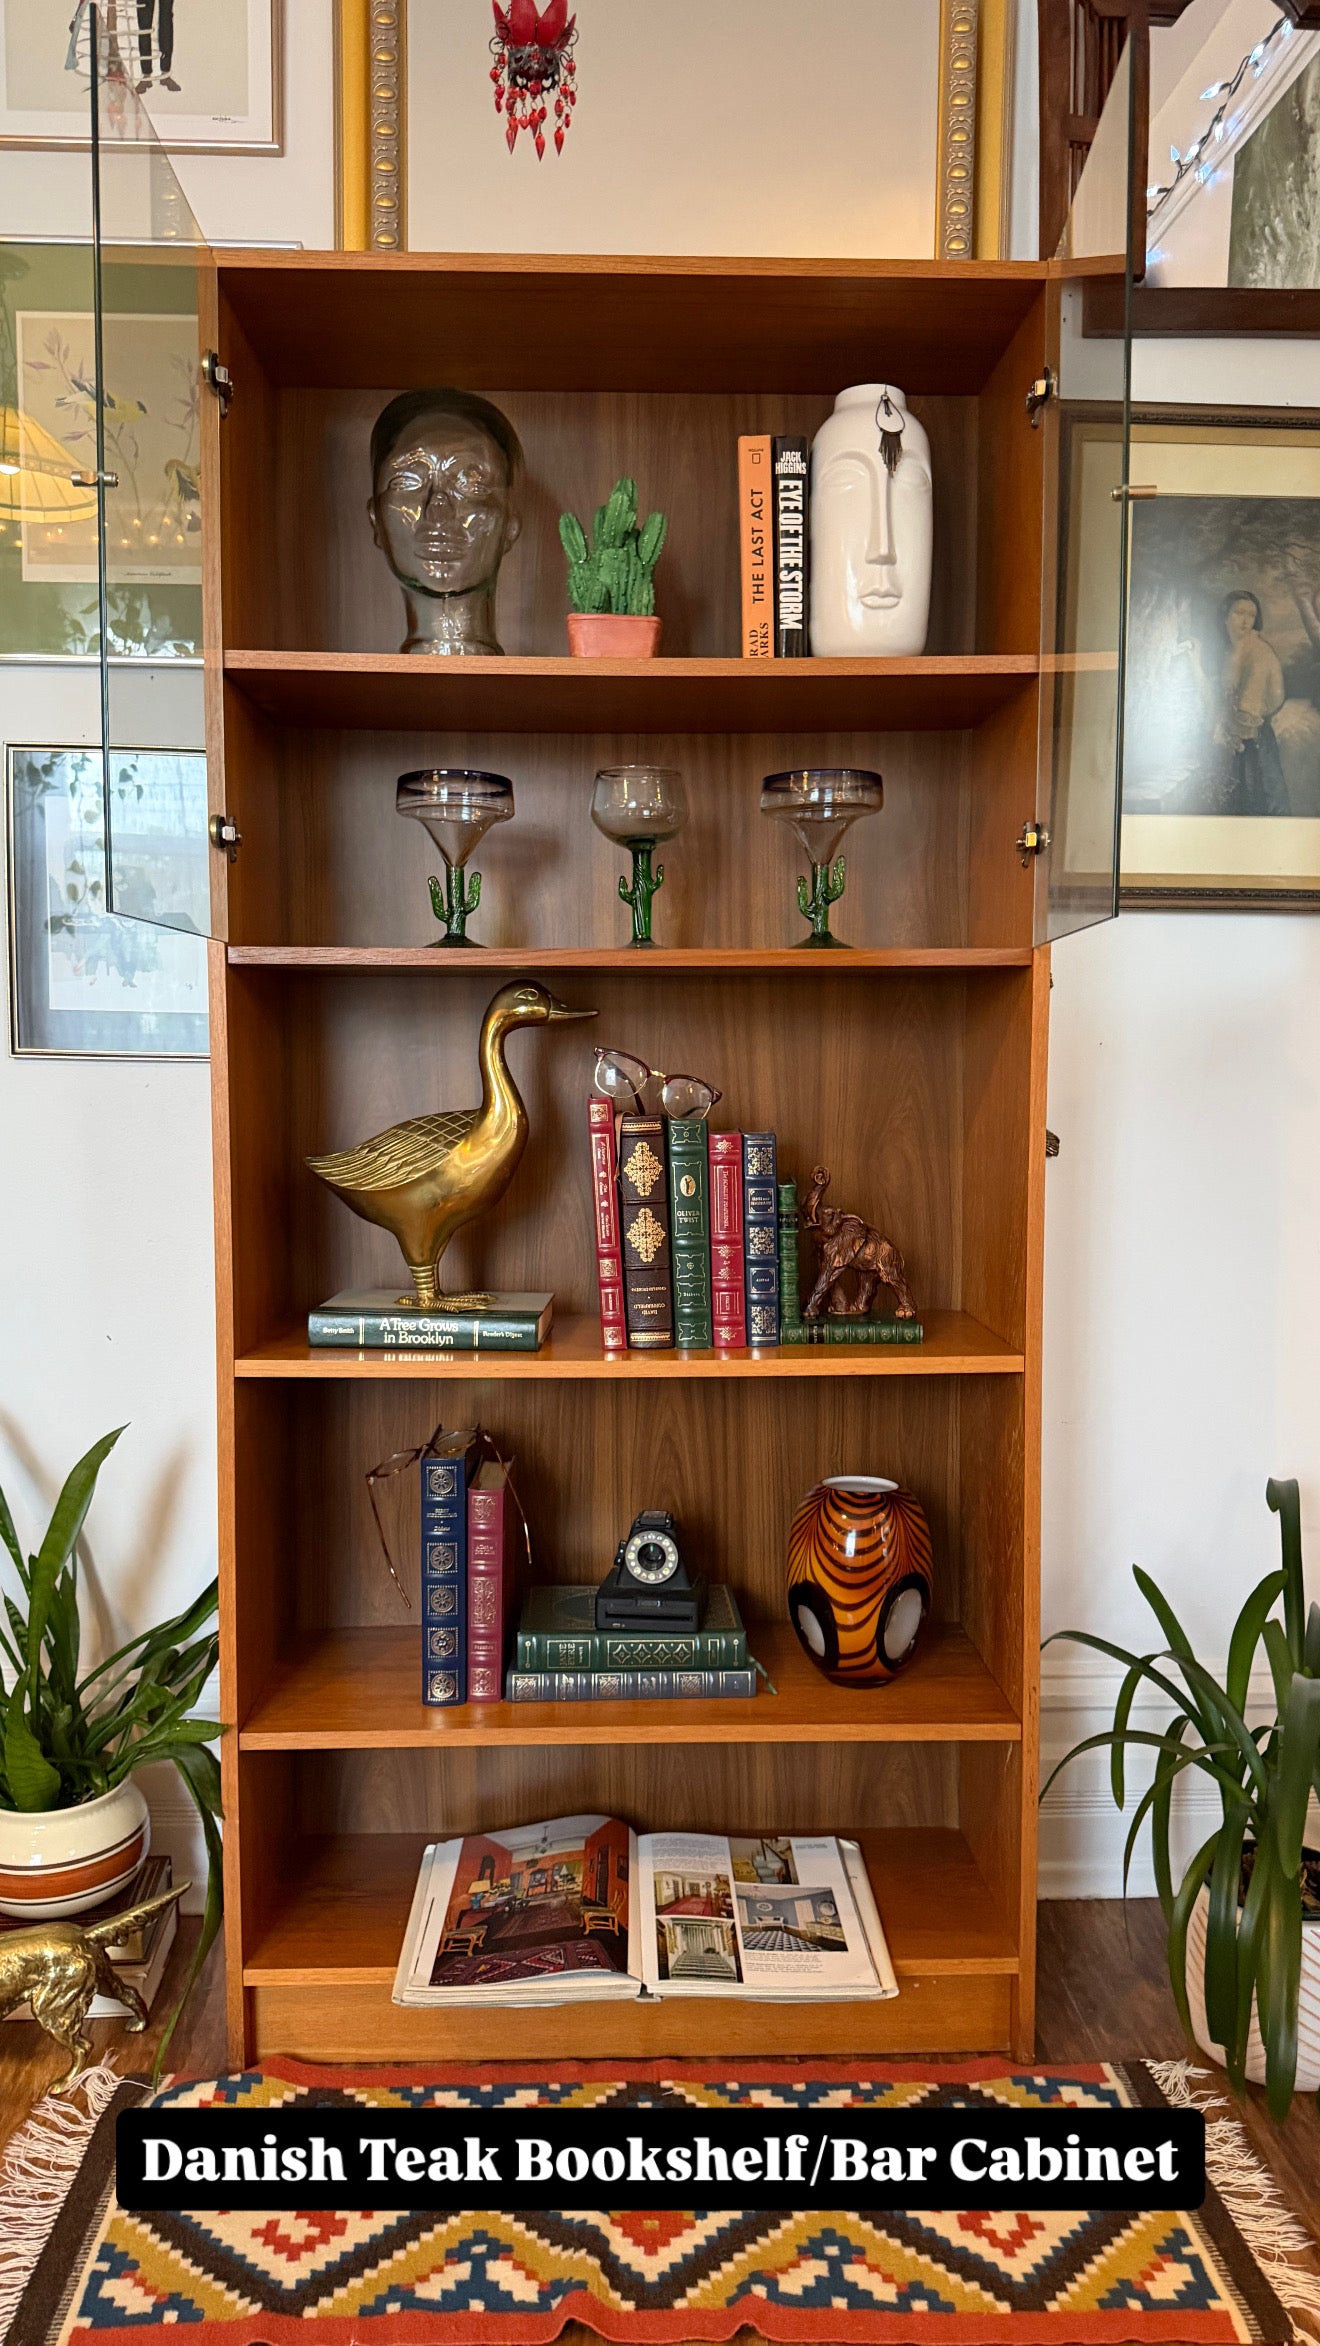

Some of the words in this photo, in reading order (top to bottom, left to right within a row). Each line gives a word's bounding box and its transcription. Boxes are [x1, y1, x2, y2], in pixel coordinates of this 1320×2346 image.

[775, 462, 807, 475] HIGGINS
[780, 451, 802, 463] JACK
[751, 488, 764, 520] ACT
[779, 480, 803, 511] EYE
[779, 512, 803, 534] OF
[751, 527, 764, 567] LAST
[779, 535, 803, 568] THE
[752, 573, 764, 604] THE
[779, 570, 803, 630] STORM
[749, 629, 759, 657] RAD
[678, 1216, 698, 1224] TWIST
[322, 1327, 338, 1335] Betty
[379, 1318, 390, 1331] A
[390, 1318, 417, 1331] Tree
[418, 1318, 459, 1332] Grows
[482, 1330, 505, 1338] Reader's
[505, 1331, 523, 1339] Digest
[384, 1331, 395, 1344] in
[398, 1331, 454, 1347] Brooklyn
[559, 1643, 568, 1666] JANE
[567, 1643, 576, 1666] EYRE
